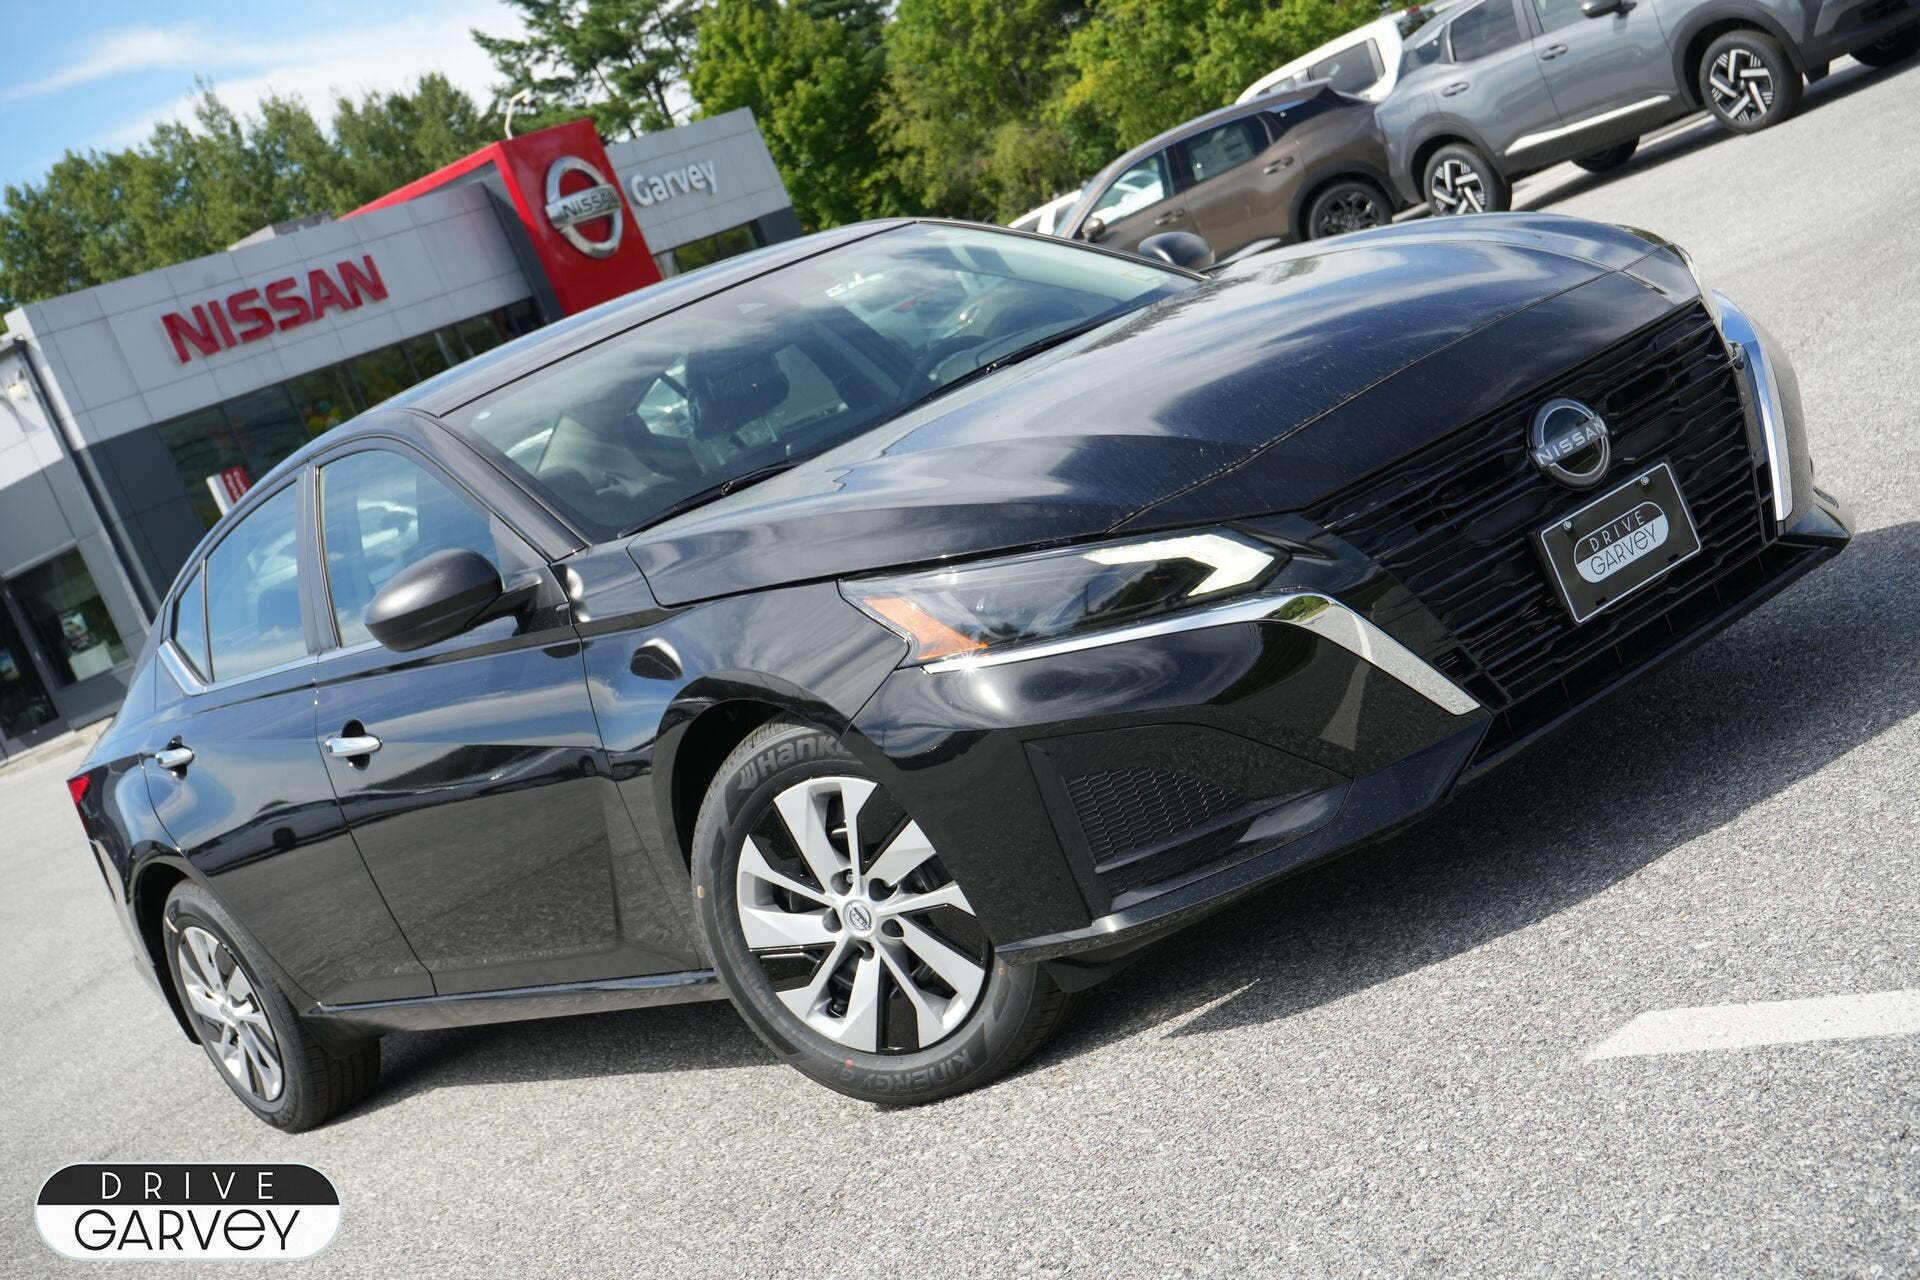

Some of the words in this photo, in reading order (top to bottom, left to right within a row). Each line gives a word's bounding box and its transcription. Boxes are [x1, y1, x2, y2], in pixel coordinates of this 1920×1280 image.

[562, 191, 617, 219] NISSAN
[630, 160, 717, 206] Garvey
[161, 254, 389, 363] NISSAN
[1536, 420, 1607, 465] NISSAN
[1590, 511, 1645, 552] DRIVE
